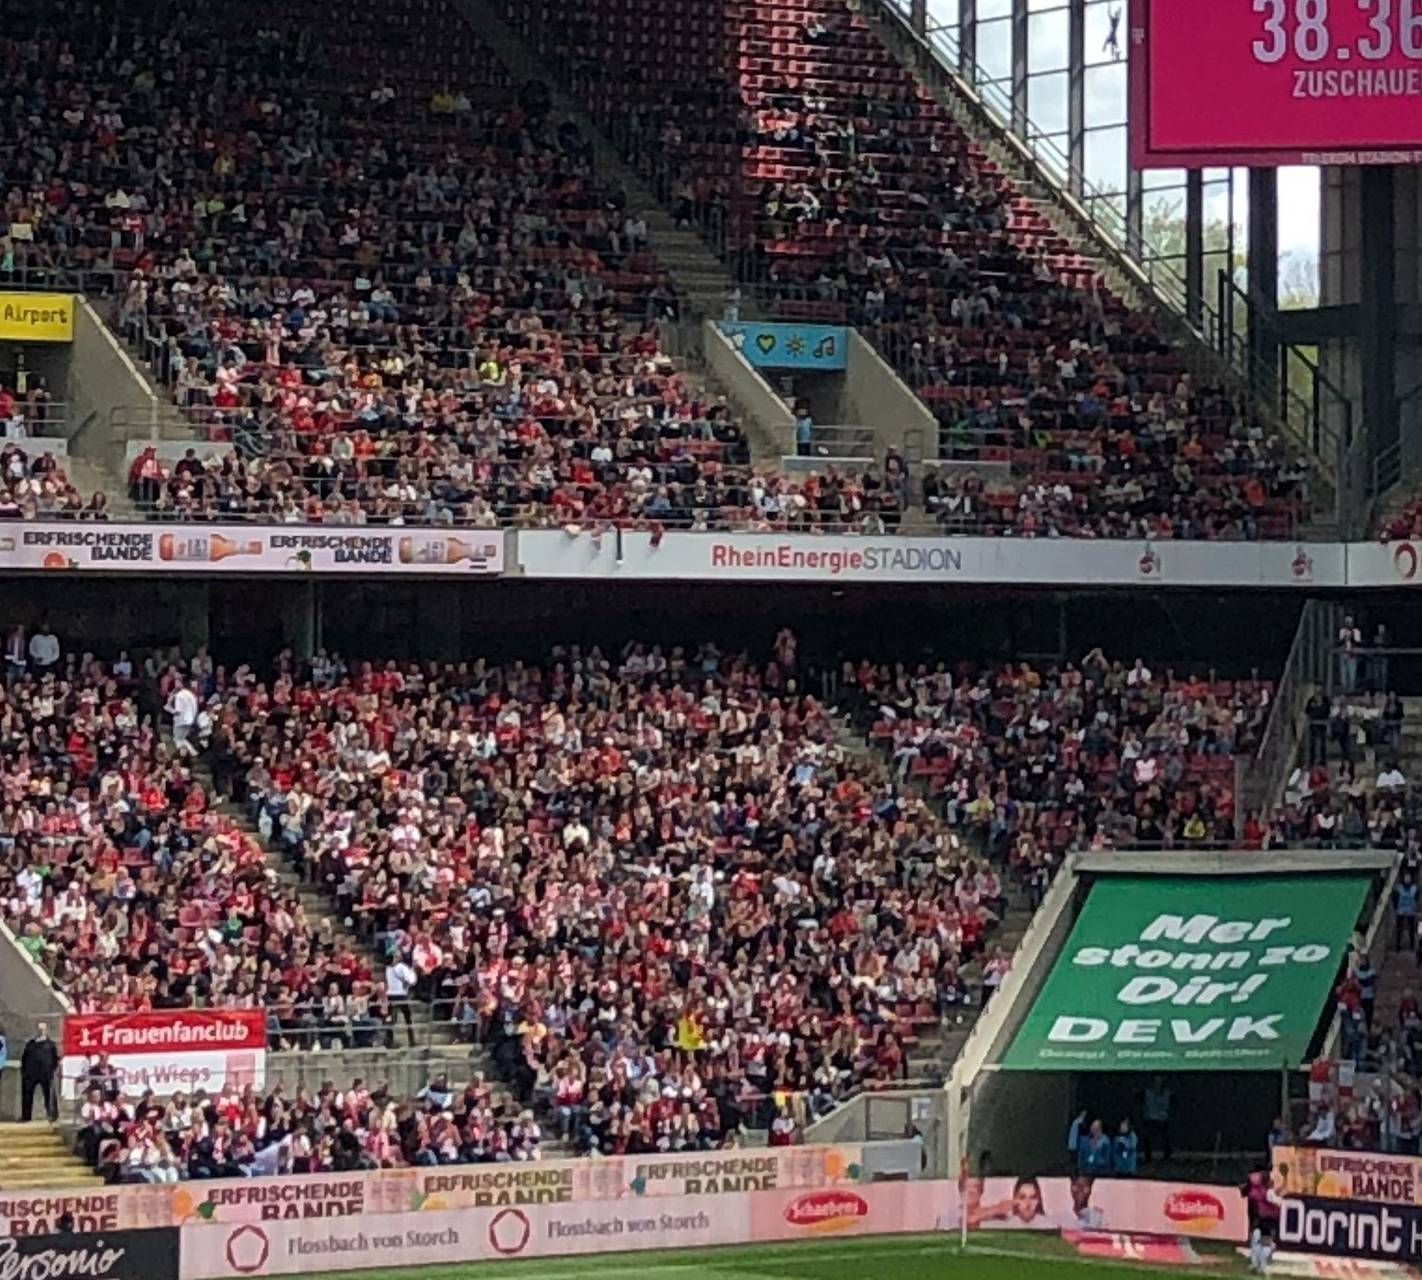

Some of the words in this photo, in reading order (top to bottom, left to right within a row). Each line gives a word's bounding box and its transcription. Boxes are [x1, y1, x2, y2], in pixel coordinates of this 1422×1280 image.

[4, 303, 68, 325] Airport
[23, 531, 153, 546] ERFRISCHENDE
[270, 535, 392, 551] ERFRISCHENDE
[91, 546, 153, 561] BANDE
[333, 549, 392, 564] BANDE
[712, 544, 962, 573] RheinEnergieSTADION
[1139, 914, 1291, 943] Mer
[1072, 943, 1252, 970] stonn
[1258, 944, 1331, 967] zo
[1116, 973, 1269, 1005] Dir!
[80, 1027, 97, 1046] 1.
[102, 1020, 249, 1046] Frauenfanclub
[1047, 1014, 1284, 1043] DEVK
[424, 1169, 573, 1193] ERFRISCHENDE
[636, 1157, 778, 1180] ERFRISCHENDE
[208, 1181, 364, 1206] ERFRISCHENDE
[1352, 1173, 1415, 1202] BANDE
[10, 1215, 118, 1238] BADE
[1280, 1199, 1402, 1253] Dorint
[288, 1234, 368, 1255] Flossbach
[372, 1235, 403, 1248] von
[406, 1228, 458, 1248] Storch
